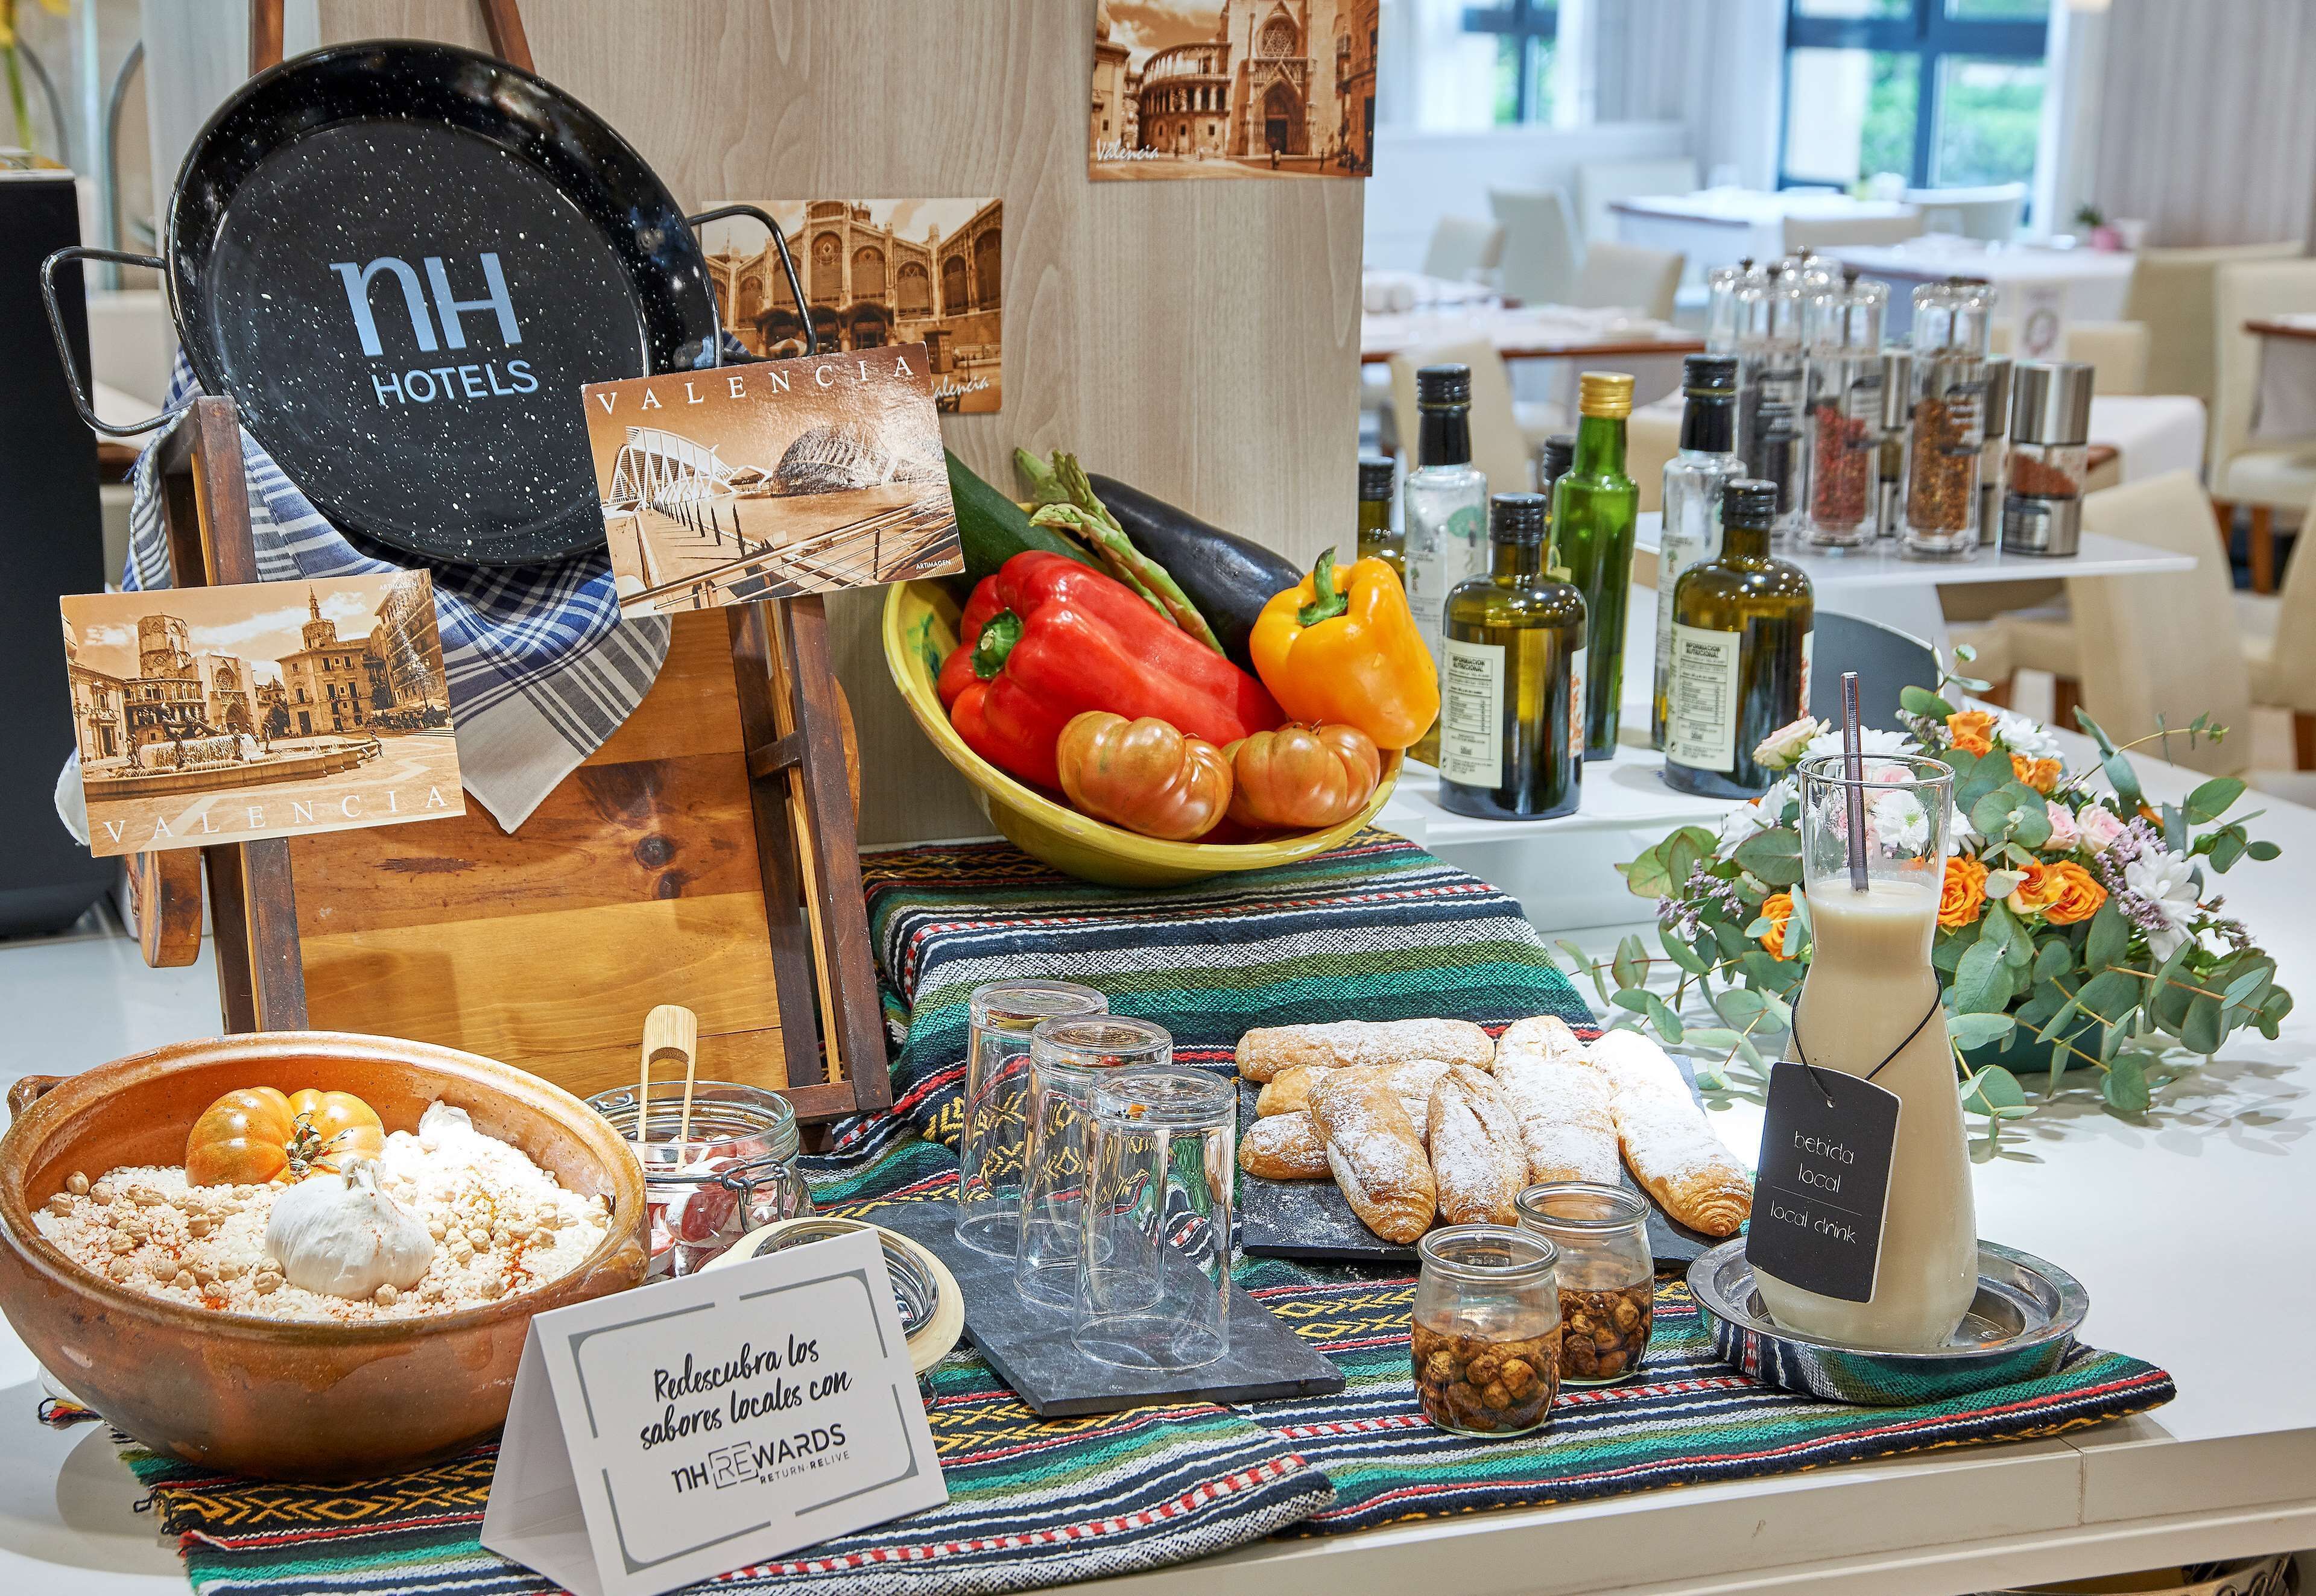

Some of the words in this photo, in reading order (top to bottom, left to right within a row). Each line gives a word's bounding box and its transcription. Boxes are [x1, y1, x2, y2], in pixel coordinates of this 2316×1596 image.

[1096, 137, 1159, 160] Valencia
[372, 359, 539, 406] HOTELS
[596, 356, 914, 415] VALENCIA
[931, 374, 989, 398] alencia
[916, 559, 952, 570] ARTIMAGEN
[103, 785, 448, 844] VALENCIA
[1794, 1131, 1854, 1164] bebida
[1798, 1162, 1841, 1193] local
[1770, 1200, 1808, 1228] local
[1814, 1217, 1856, 1244] drink
[654, 1342, 782, 1402] Redescubra
[788, 1333, 819, 1367] los
[640, 1404, 722, 1450] sabores
[730, 1377, 803, 1423] locales
[809, 1370, 853, 1401] con
